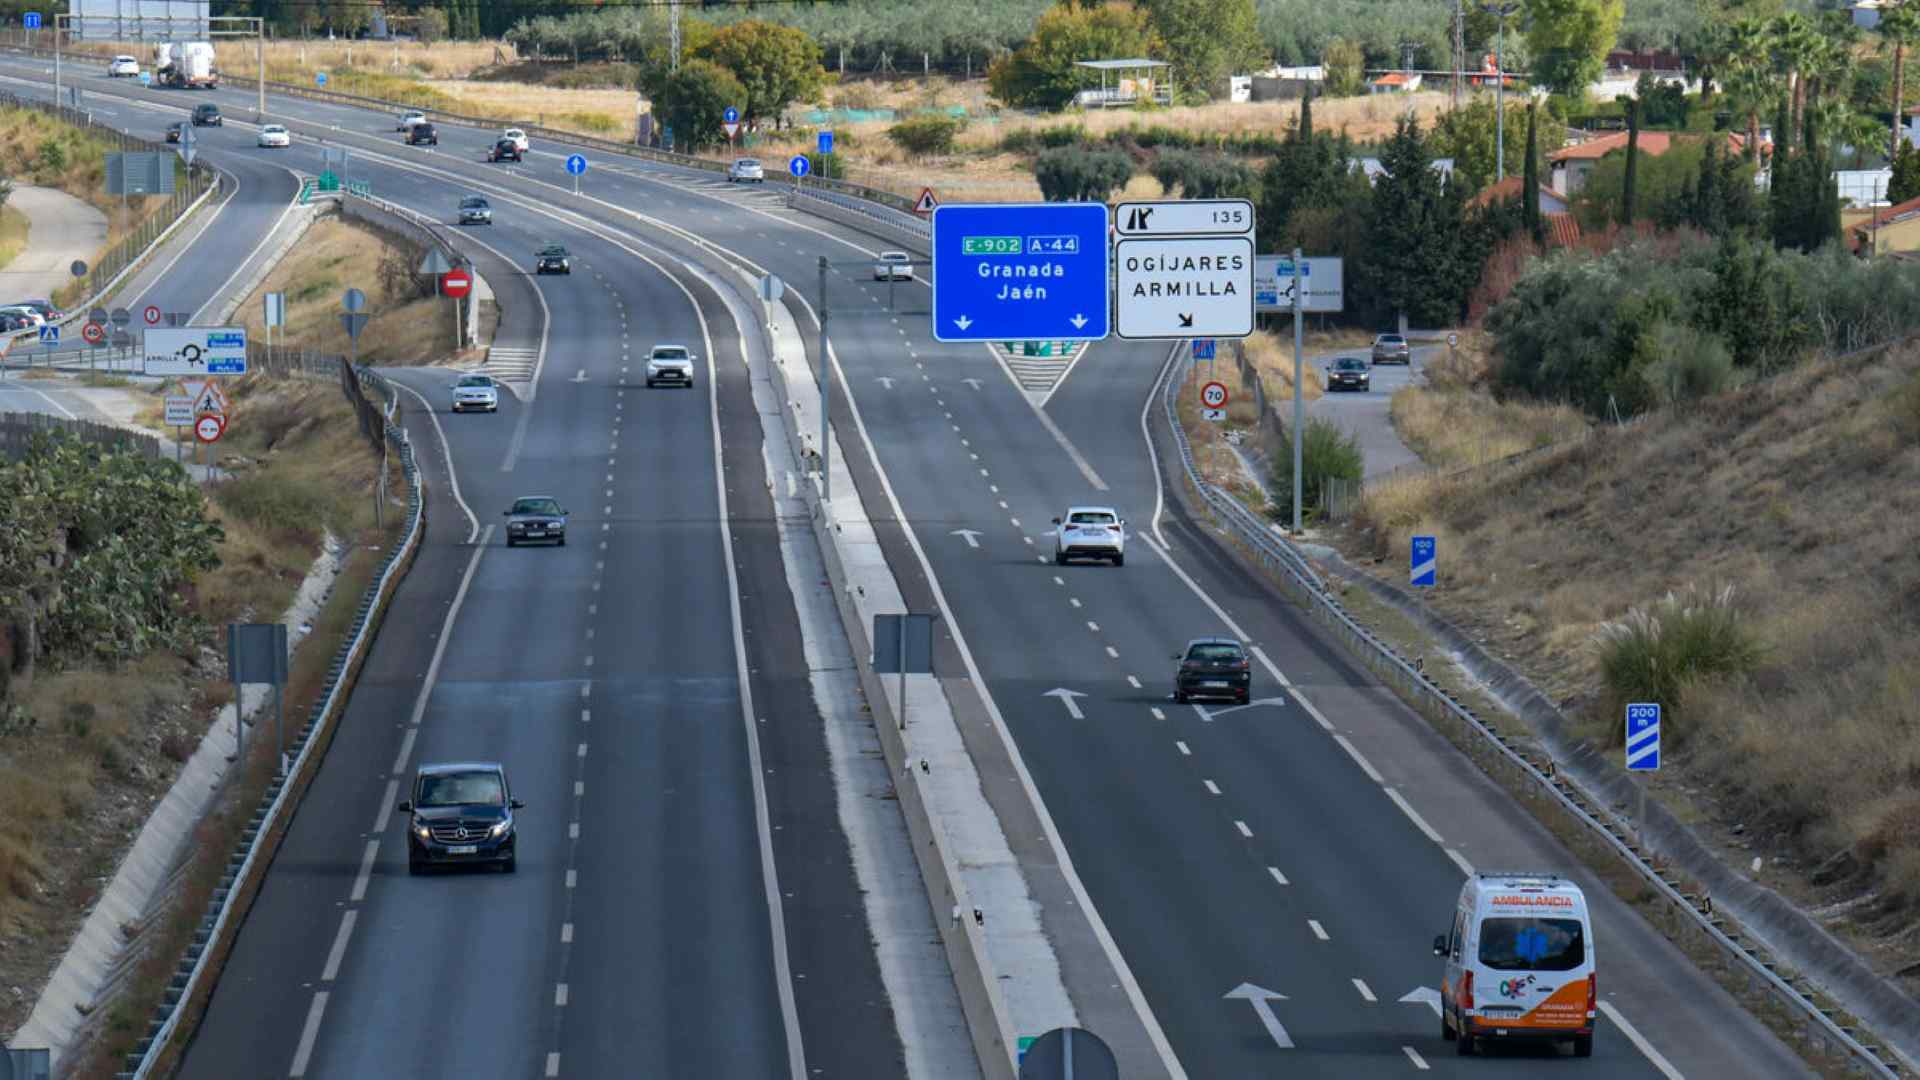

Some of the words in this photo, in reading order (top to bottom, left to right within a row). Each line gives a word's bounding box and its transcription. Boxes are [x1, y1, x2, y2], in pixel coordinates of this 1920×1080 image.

[1213, 211, 1243, 223] 135
[965, 239, 1019, 252] E-902
[1031, 238, 1076, 251] A-44
[978, 262, 1065, 277] Granada
[1126, 255, 1243, 272] OGÍJARES
[997, 284, 1047, 300] Jaén
[1133, 281, 1237, 297] ARMILLA
[1207, 391, 1222, 401] 70
[1415, 541, 1432, 549] 100
[1631, 707, 1656, 718] 200
[1637, 719, 1649, 727] m
[1492, 895, 1574, 906] AMBULANCIA
